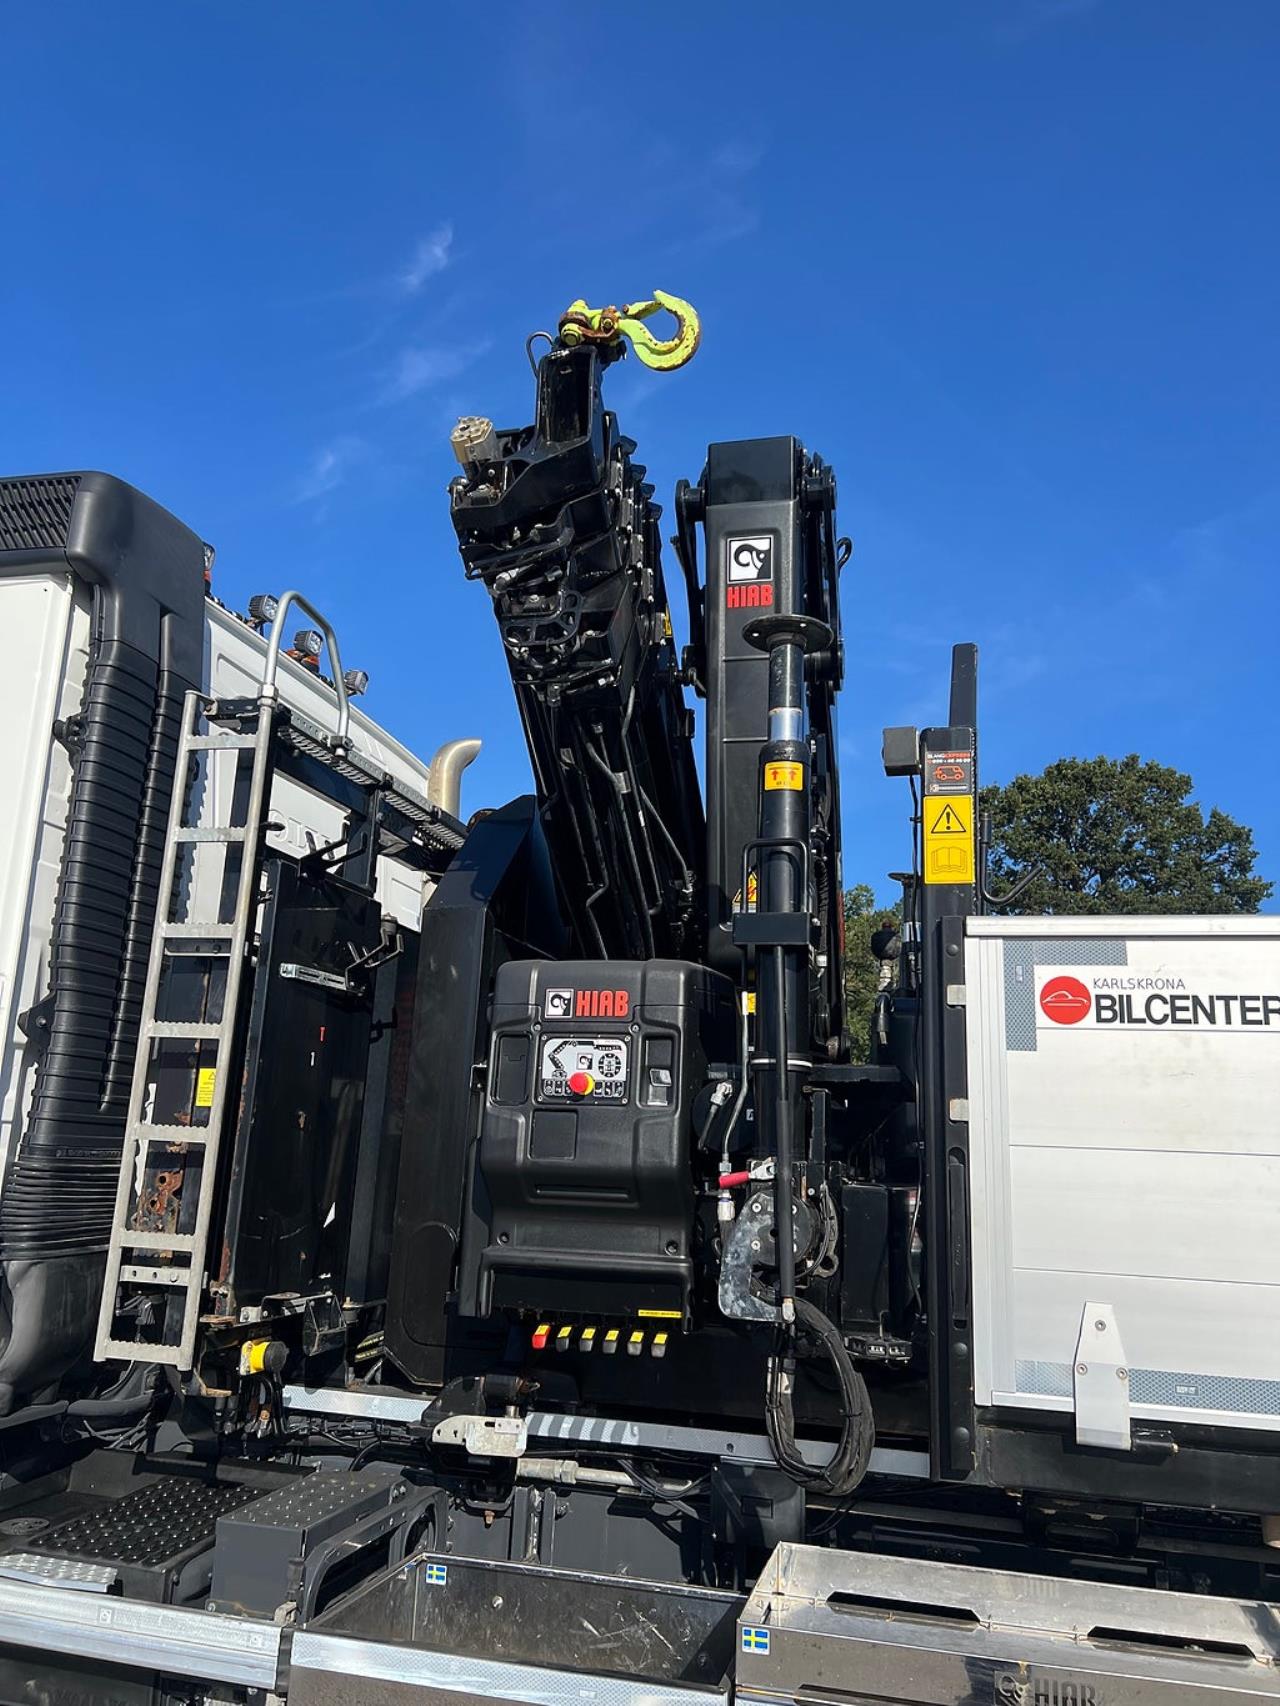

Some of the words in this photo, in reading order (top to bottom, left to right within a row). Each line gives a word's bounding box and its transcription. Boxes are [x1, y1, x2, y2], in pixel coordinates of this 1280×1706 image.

[726, 584, 774, 609] HIAB
[1093, 978, 1186, 991] KARLSKRONA
[576, 990, 629, 1017] HIAB
[1095, 993, 1280, 1026] BILCENTER
